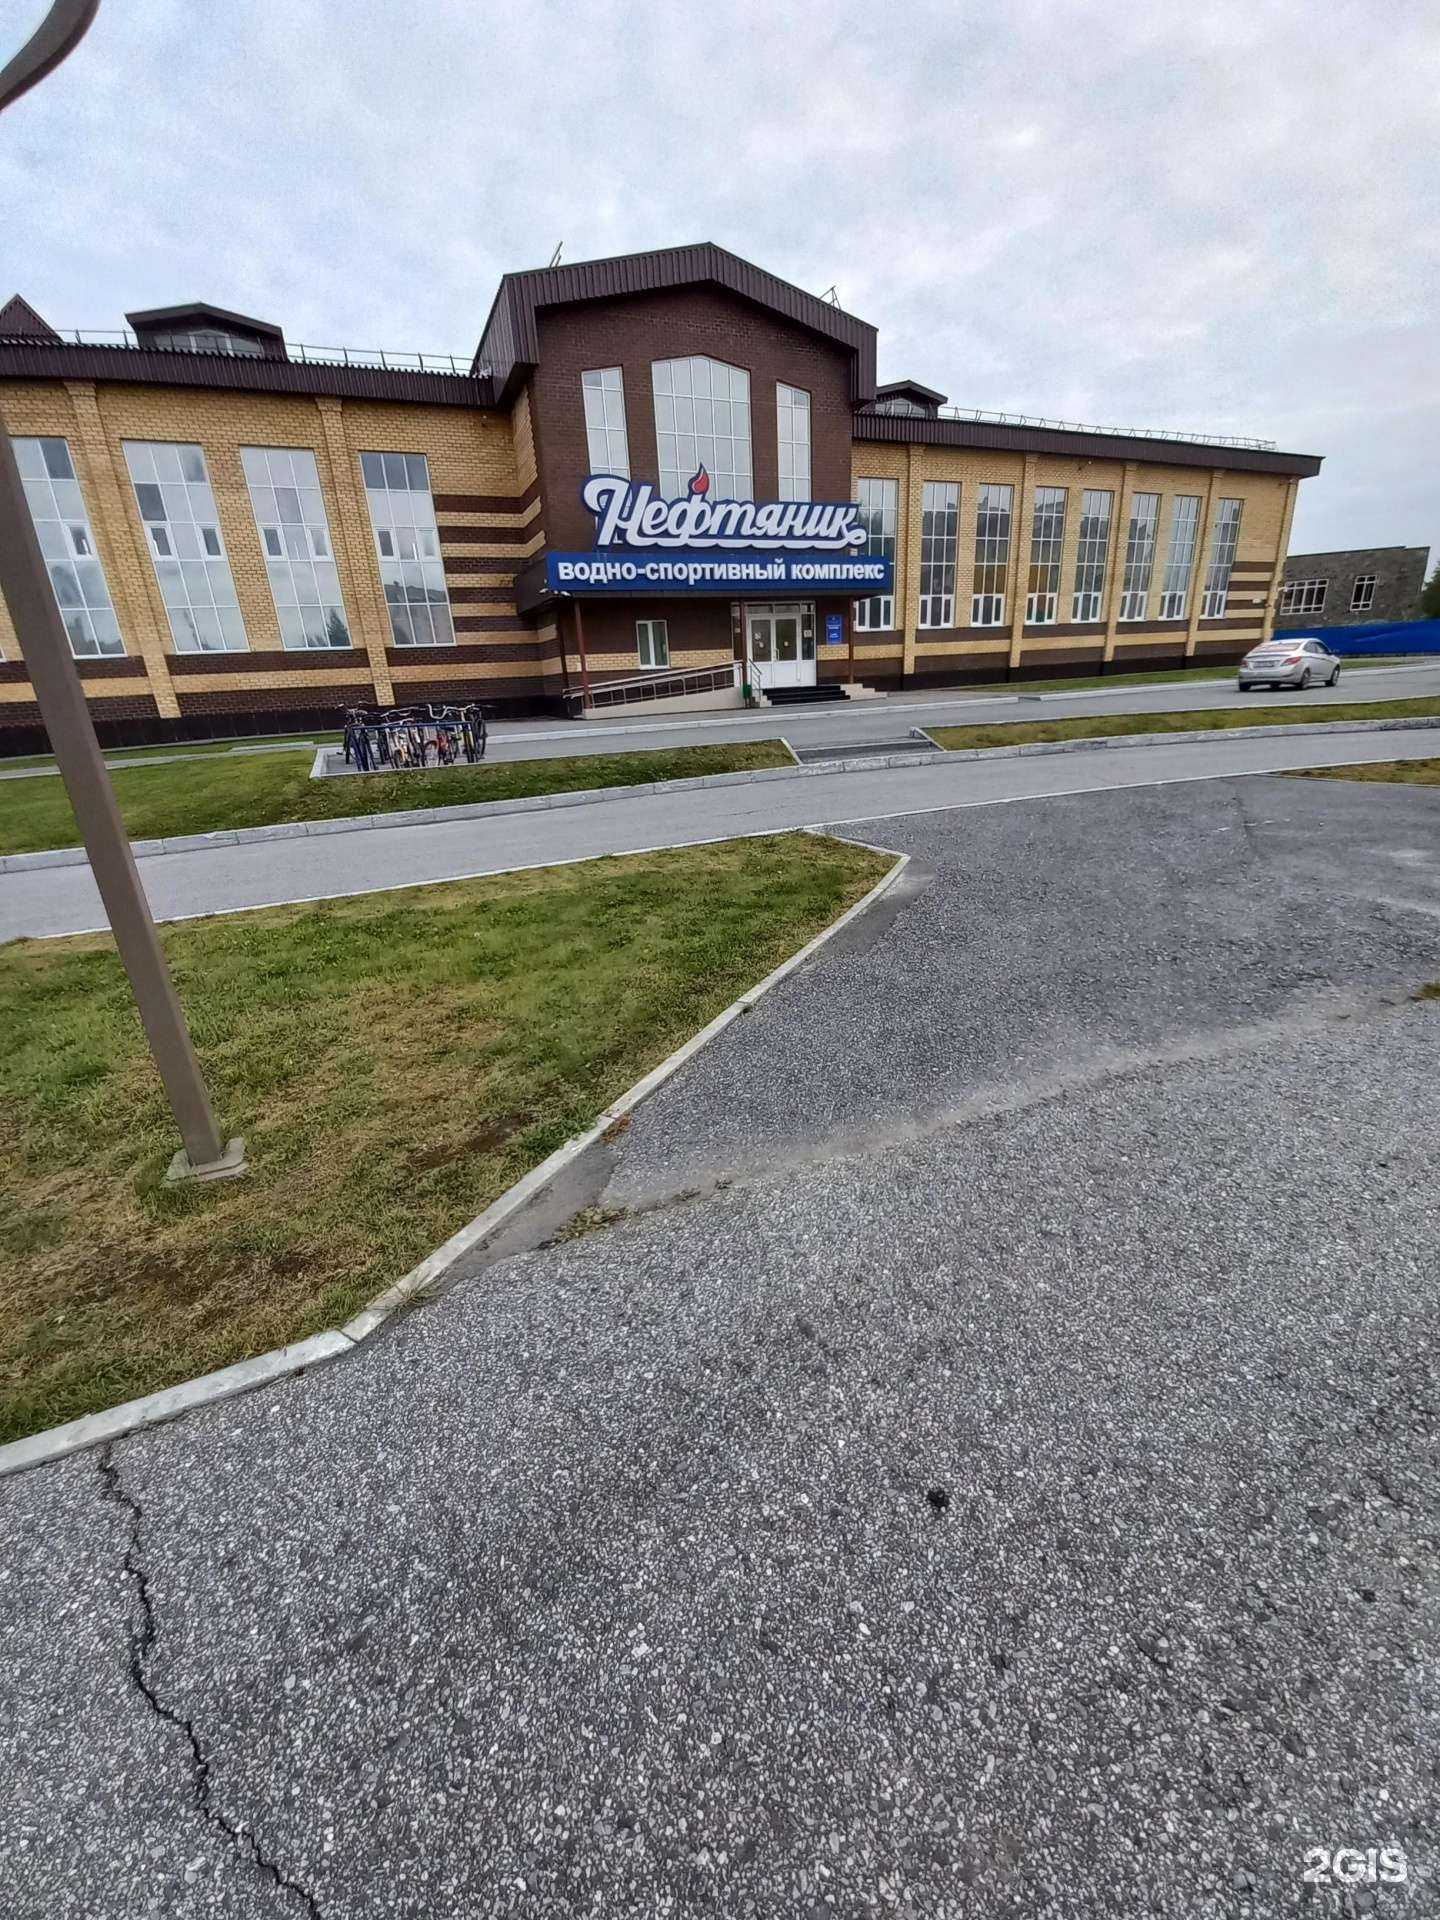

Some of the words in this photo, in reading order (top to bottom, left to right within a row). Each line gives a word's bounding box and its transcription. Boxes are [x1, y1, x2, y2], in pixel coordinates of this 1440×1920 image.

[582, 475, 868, 549] Нефтяник
[557, 559, 786, 585] водно-спортивный
[790, 564, 885, 581] комплекс
